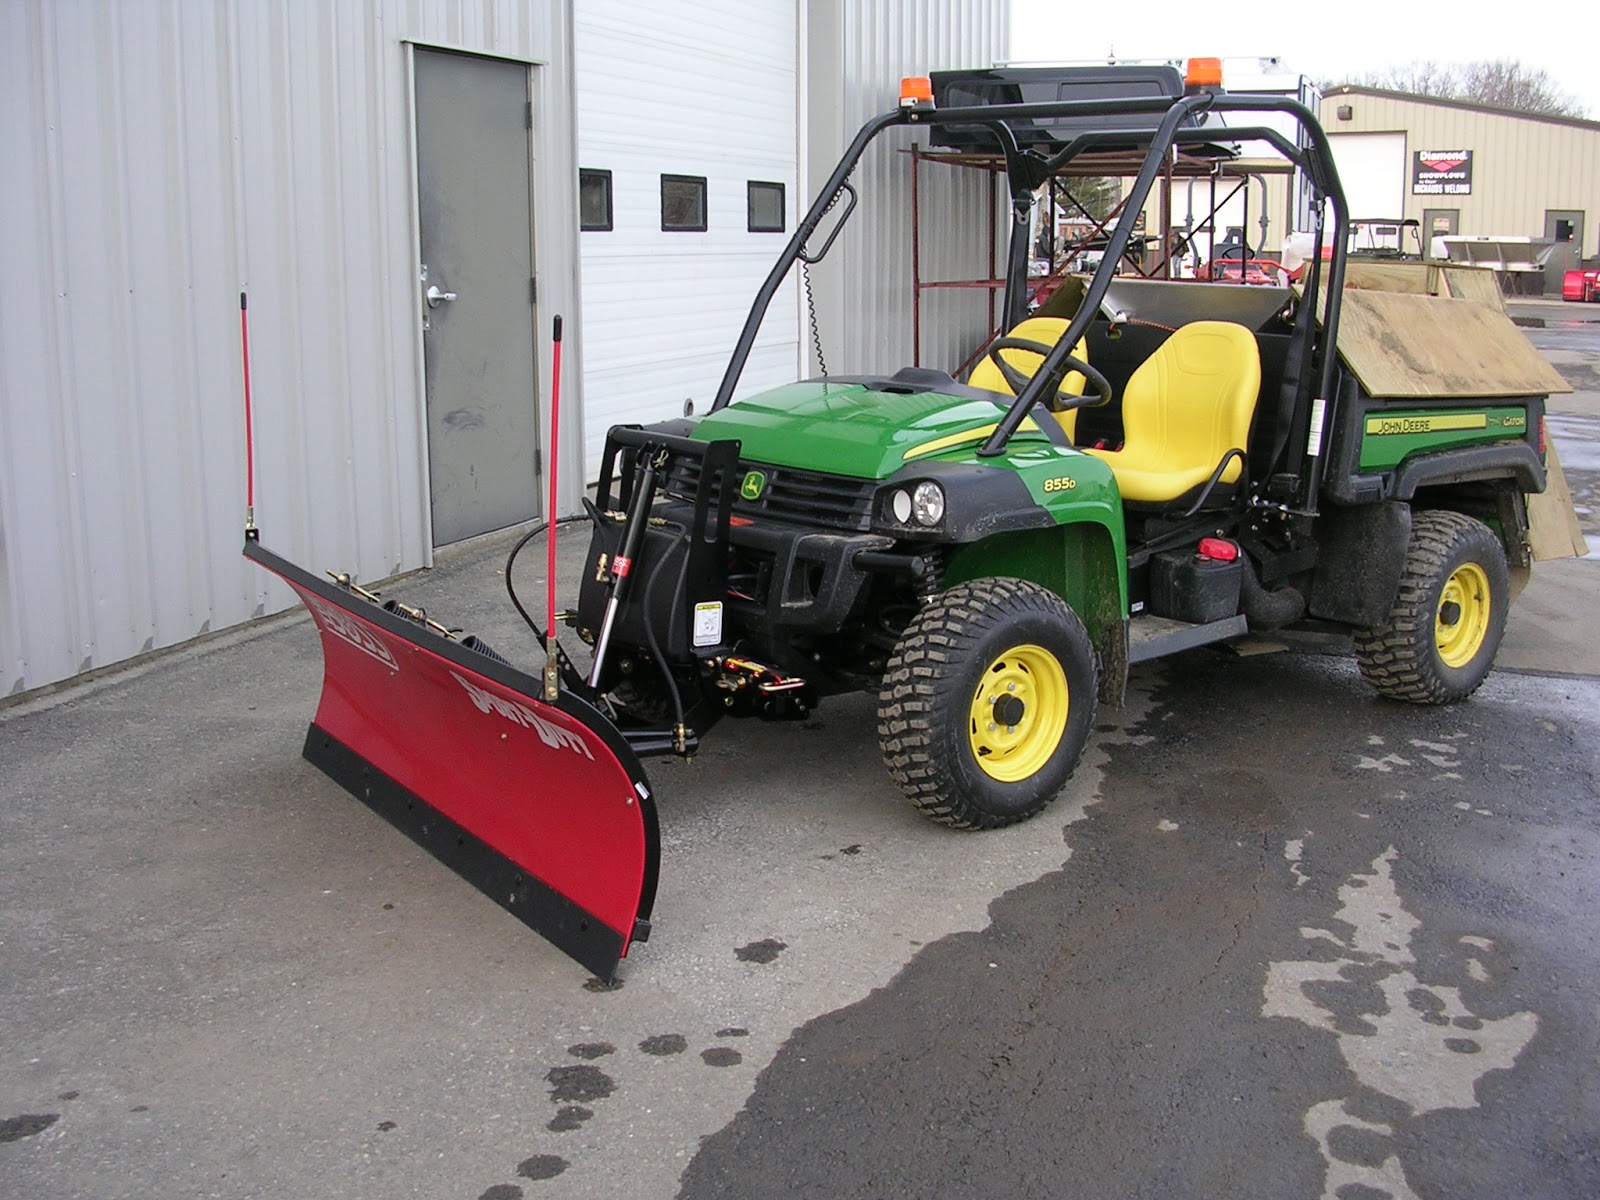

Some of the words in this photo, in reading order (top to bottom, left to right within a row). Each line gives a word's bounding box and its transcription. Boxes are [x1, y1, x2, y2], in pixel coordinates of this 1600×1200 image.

[1420, 151, 1467, 161] Diamond
[1378, 420, 1401, 433] JOHN
[1403, 419, 1431, 432] DEERE
[1044, 477, 1076, 492] 855D
